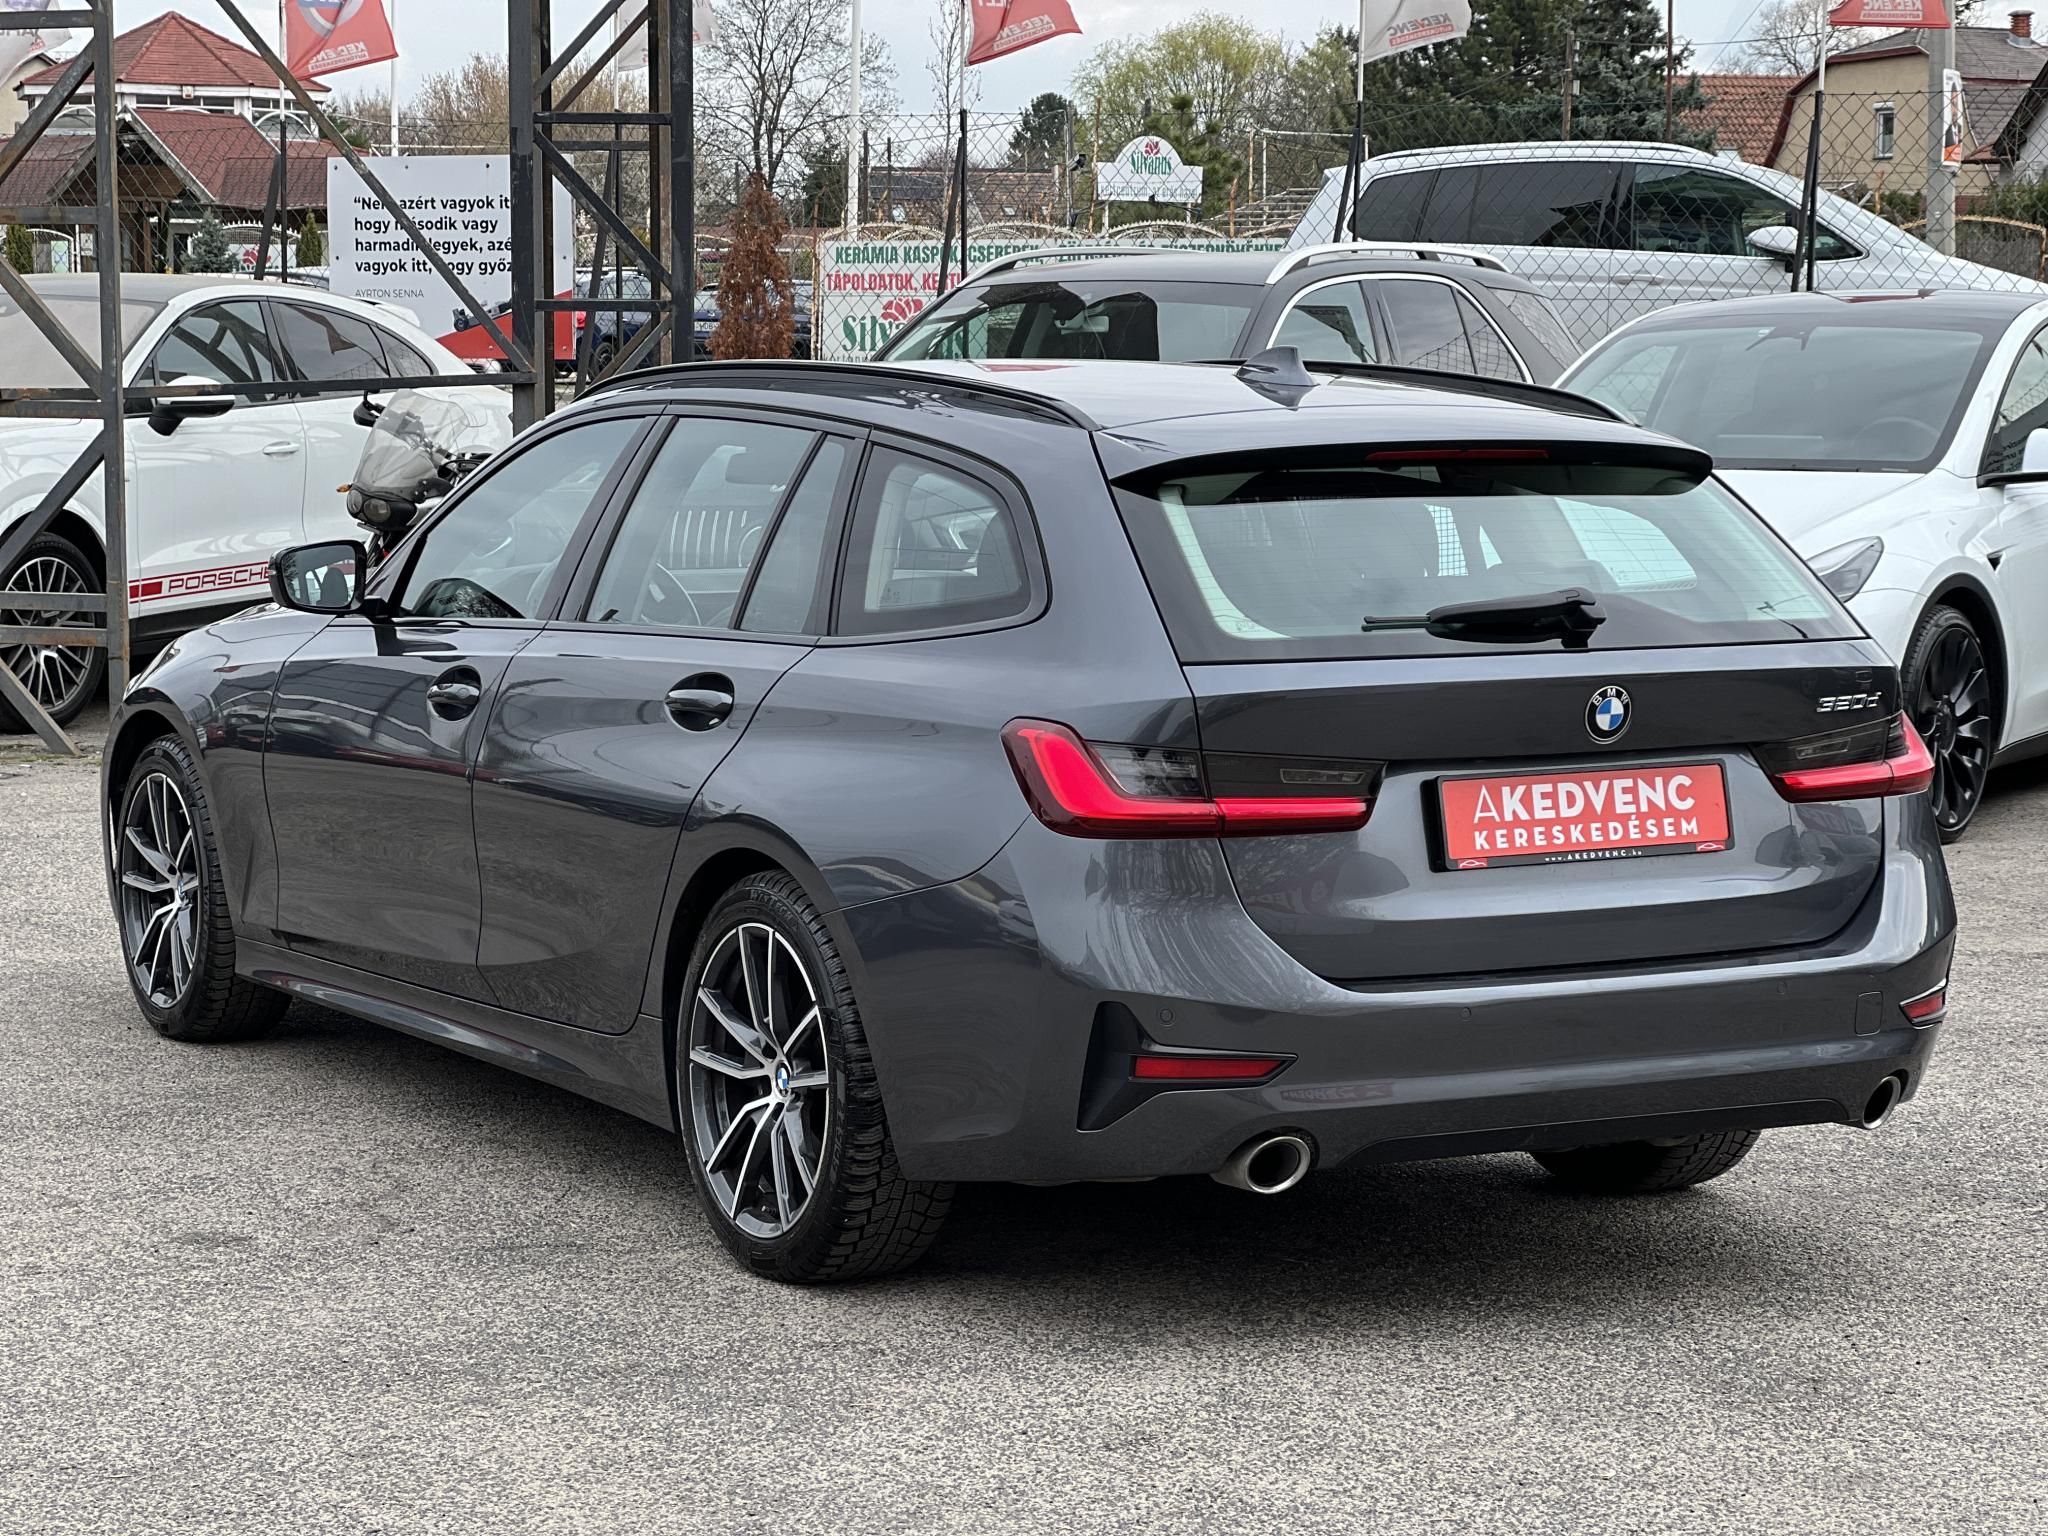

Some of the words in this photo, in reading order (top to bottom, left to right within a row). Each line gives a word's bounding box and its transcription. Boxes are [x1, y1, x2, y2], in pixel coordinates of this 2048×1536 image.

[399, 195, 436, 210] azért
[440, 195, 495, 213] vagyok
[499, 194, 510, 210] it
[354, 217, 391, 234] hogy
[461, 219, 498, 234] vagy
[355, 237, 419, 251] harmadi
[487, 237, 512, 251] azé
[835, 243, 898, 265] KERÁMIA
[355, 258, 408, 276] vagyok
[411, 257, 432, 275] itt,
[447, 261, 474, 276] ogy
[478, 257, 512, 276] győz
[826, 270, 918, 292] TÁPOLDATOK,
[355, 288, 392, 298] AYRTON
[393, 288, 425, 298] SENNA
[1592, 687, 1630, 706] BMW
[1816, 691, 1882, 713] 320d
[1473, 774, 1696, 824] AKEDVENC
[1473, 815, 1700, 850] KERESKEDÉSEM
[1544, 849, 1643, 862] www.AKEDVENC.hu
